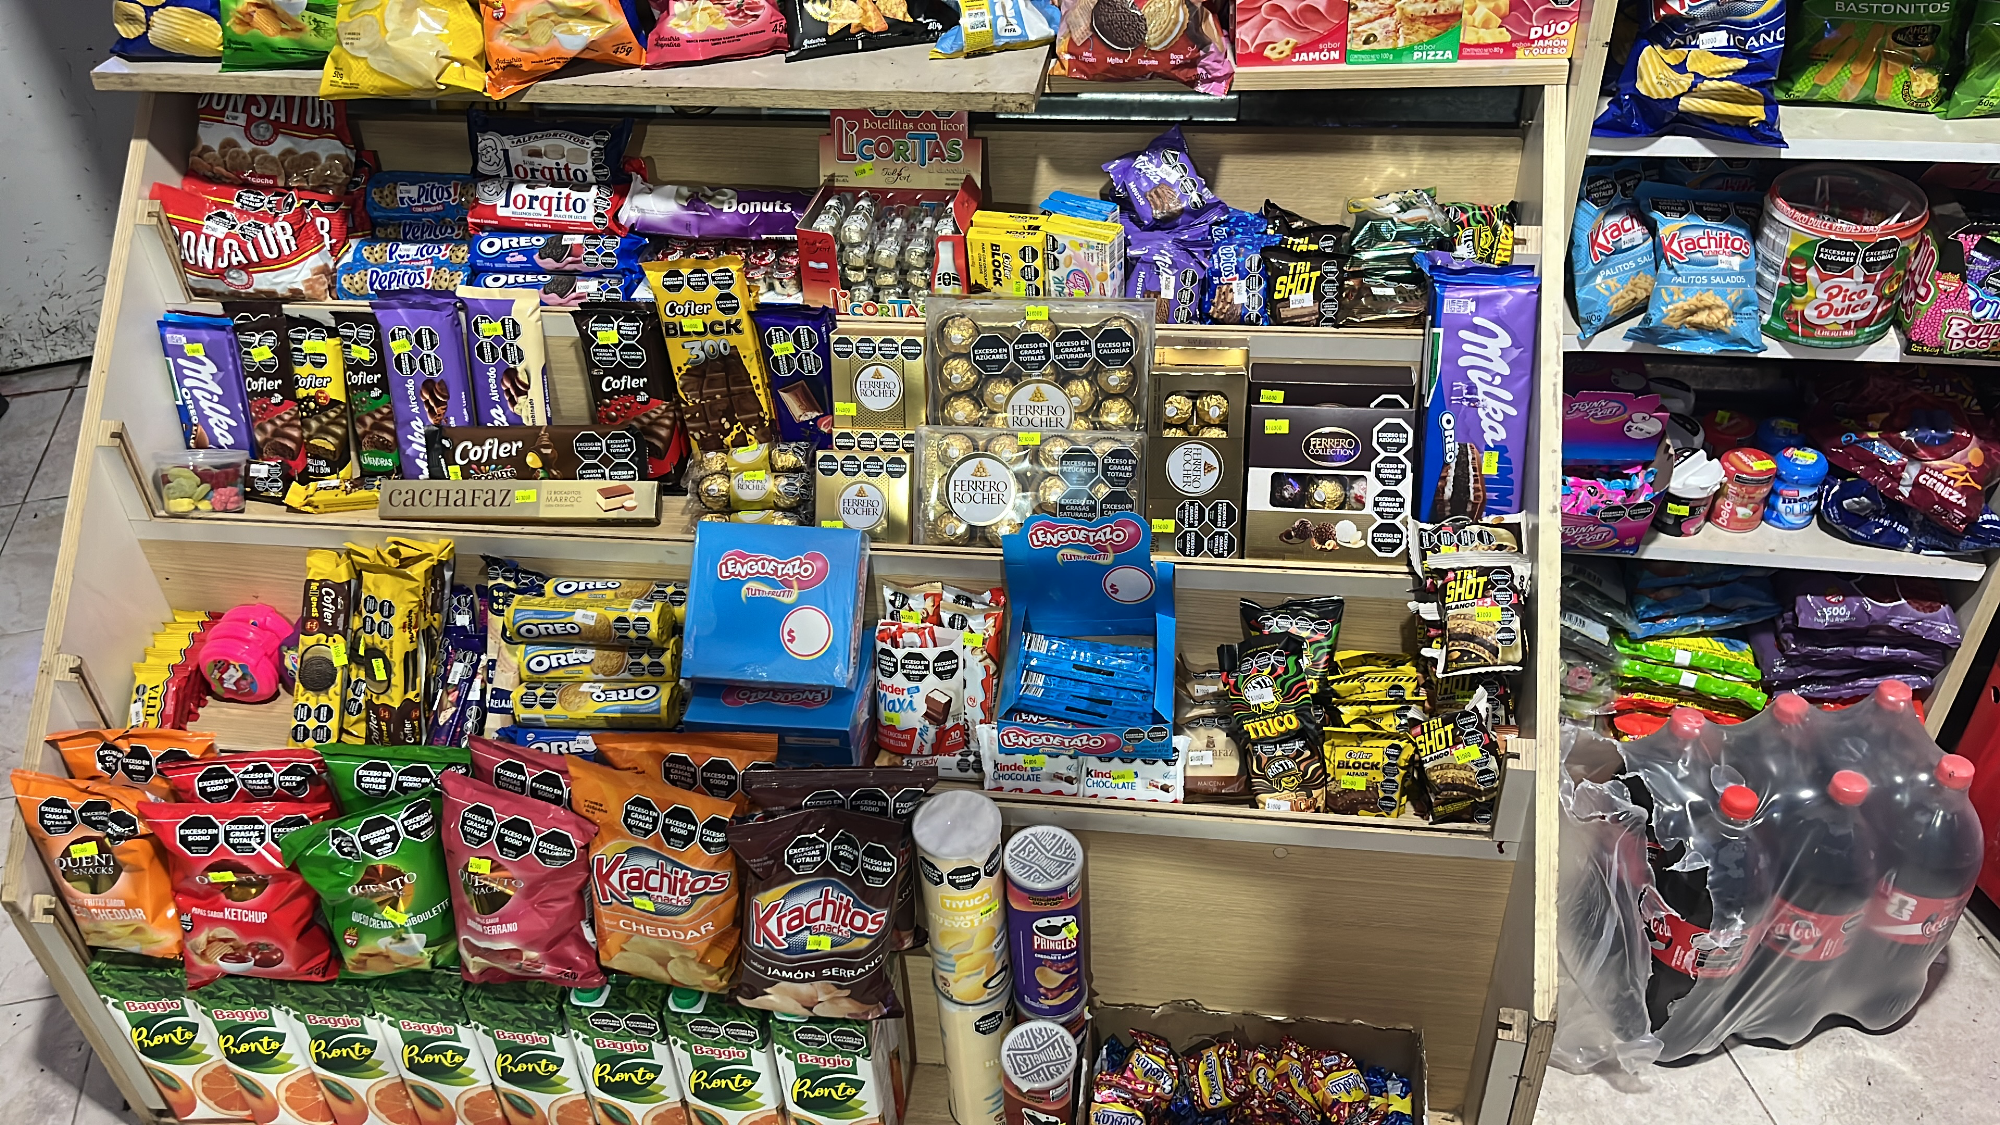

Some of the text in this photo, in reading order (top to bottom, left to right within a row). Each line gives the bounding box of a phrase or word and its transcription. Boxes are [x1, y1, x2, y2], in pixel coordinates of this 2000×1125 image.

[1835, 1, 1950, 14] BASTONITOS
[1530, 20, 1570, 39] DÚO
[1319, 41, 1340, 49] sabor
[1413, 44, 1436, 52] sabor
[1531, 38, 1568, 48] JAMÓN
[1291, 47, 1340, 62] JAMÓN
[1413, 51, 1453, 61] PIZZA
[1531, 47, 1567, 56] QUESO
[863, 118, 965, 132] Botellitas con licor
[835, 115, 964, 168] LICORITAS
[499, 184, 588, 213] Jorgito
[1128, 181, 1146, 206] Mousse
[723, 199, 790, 214] Donuts
[1808, 217, 1830, 231] DULCE
[480, 234, 547, 253] OREO
[1660, 228, 1751, 267] Krachitos
[1703, 249, 1732, 257] snacks
[1818, 253, 1854, 263] AZÚCARES
[1820, 248, 1844, 256] EXCESO
[990, 242, 1002, 289] BLOCK
[1288, 262, 1311, 274] TRI
[1600, 261, 1635, 279] PALITOS
[367, 267, 432, 291] Pepitos!
[1273, 270, 1321, 299] SHOT
[1671, 274, 1746, 284] PALITOS SALADOS
[1823, 283, 1867, 304] Pico
[665, 301, 711, 317] Cofler
[1813, 300, 1871, 319] Dulce
[682, 339, 730, 365] 300
[974, 348, 997, 356] EXCESO
[1950, 338, 1990, 351] DOG
[976, 353, 1008, 361] AZÚCARES
[1019, 354, 1046, 362] TOTALES
[1055, 352, 1092, 360] SATURADAS
[246, 377, 282, 391] Cofler
[294, 375, 331, 388] Cofler
[346, 371, 381, 385] Cofler
[488, 366, 498, 402] Aireado
[602, 376, 648, 391] Cofler
[1457, 316, 1518, 448] Milka
[859, 381, 896, 391] FERRERO
[860, 388, 896, 398] ROCHER
[177, 355, 238, 449] Milka
[407, 379, 420, 413] Aireado
[636, 393, 650, 403] air
[1012, 404, 1065, 416] FERRERO
[1012, 416, 1065, 428] ROCHER
[1309, 437, 1356, 449] FERRERO
[1438, 411, 1456, 463] OREO
[455, 438, 523, 465] Cofler
[1308, 447, 1355, 456] COLLECTION
[1183, 447, 1193, 488] ROCHER
[1193, 447, 1202, 489] FERRERO
[953, 479, 1008, 492] FERRERO
[1918, 477, 1968, 507] CEREZA
[842, 499, 880, 508] FERRERO
[953, 491, 1007, 505] ROCHER
[1717, 482, 1738, 527] beldent
[842, 506, 879, 516] ROCHER
[1031, 526, 1125, 546] LENGÜETAZO
[719, 555, 814, 578] LENGÜETAZO
[1456, 569, 1477, 581] TRI
[556, 580, 621, 595] OREO
[1109, 583, 1119, 595] $
[1445, 579, 1488, 602] SHOT
[322, 587, 335, 627] Cofler
[1445, 602, 1476, 612] BLANCO
[518, 623, 581, 638] OREO
[787, 628, 796, 645] $
[592, 685, 658, 702] OREO
[877, 680, 906, 696] kinder
[878, 695, 916, 713] Maxi
[1244, 714, 1299, 740] TRICO
[1421, 717, 1443, 734] TRI
[1001, 732, 1103, 748] LENGÜETAZO
[1416, 725, 1456, 756] SHOT
[1346, 750, 1373, 759] Cofler
[1420, 750, 1450, 764] BLANCO
[1267, 760, 1294, 779] RASTA
[1337, 760, 1381, 771] BLOCK
[993, 772, 1041, 782] CHOCOLATE
[1085, 778, 1137, 791] CHOCOLATE
[72, 866, 115, 876] SNACKS
[593, 853, 731, 905] Krachitos
[650, 893, 692, 907] snacks
[943, 892, 990, 909] TIYUCA
[91, 907, 146, 922] CHEDDAR
[224, 906, 268, 924] KETCHUP
[753, 887, 888, 950] Krachitos
[483, 922, 518, 935] SERRANO
[619, 919, 715, 941] CHEDDAR
[811, 923, 851, 938] snacks
[1033, 935, 1077, 950] PRINGLES
[767, 953, 883, 980] JAMÓN SERRANO
[124, 998, 180, 1013] Baggio
[213, 1008, 268, 1021] Baggio
[307, 1014, 362, 1028] Baggio
[400, 1020, 455, 1035] Baggio
[131, 1027, 194, 1051] Pronto
[495, 1030, 549, 1044] Baggio
[218, 1034, 285, 1058] Pronto
[310, 1039, 375, 1064] Pronto
[595, 1037, 648, 1053] Baggio
[693, 1045, 747, 1058] Baggio
[403, 1043, 467, 1070] Pronto
[797, 1052, 852, 1067] Baggio
[495, 1053, 561, 1077] Pronto
[593, 1063, 660, 1086] Pronto
[689, 1069, 755, 1094] Pronto
[791, 1077, 858, 1103] Pronto
